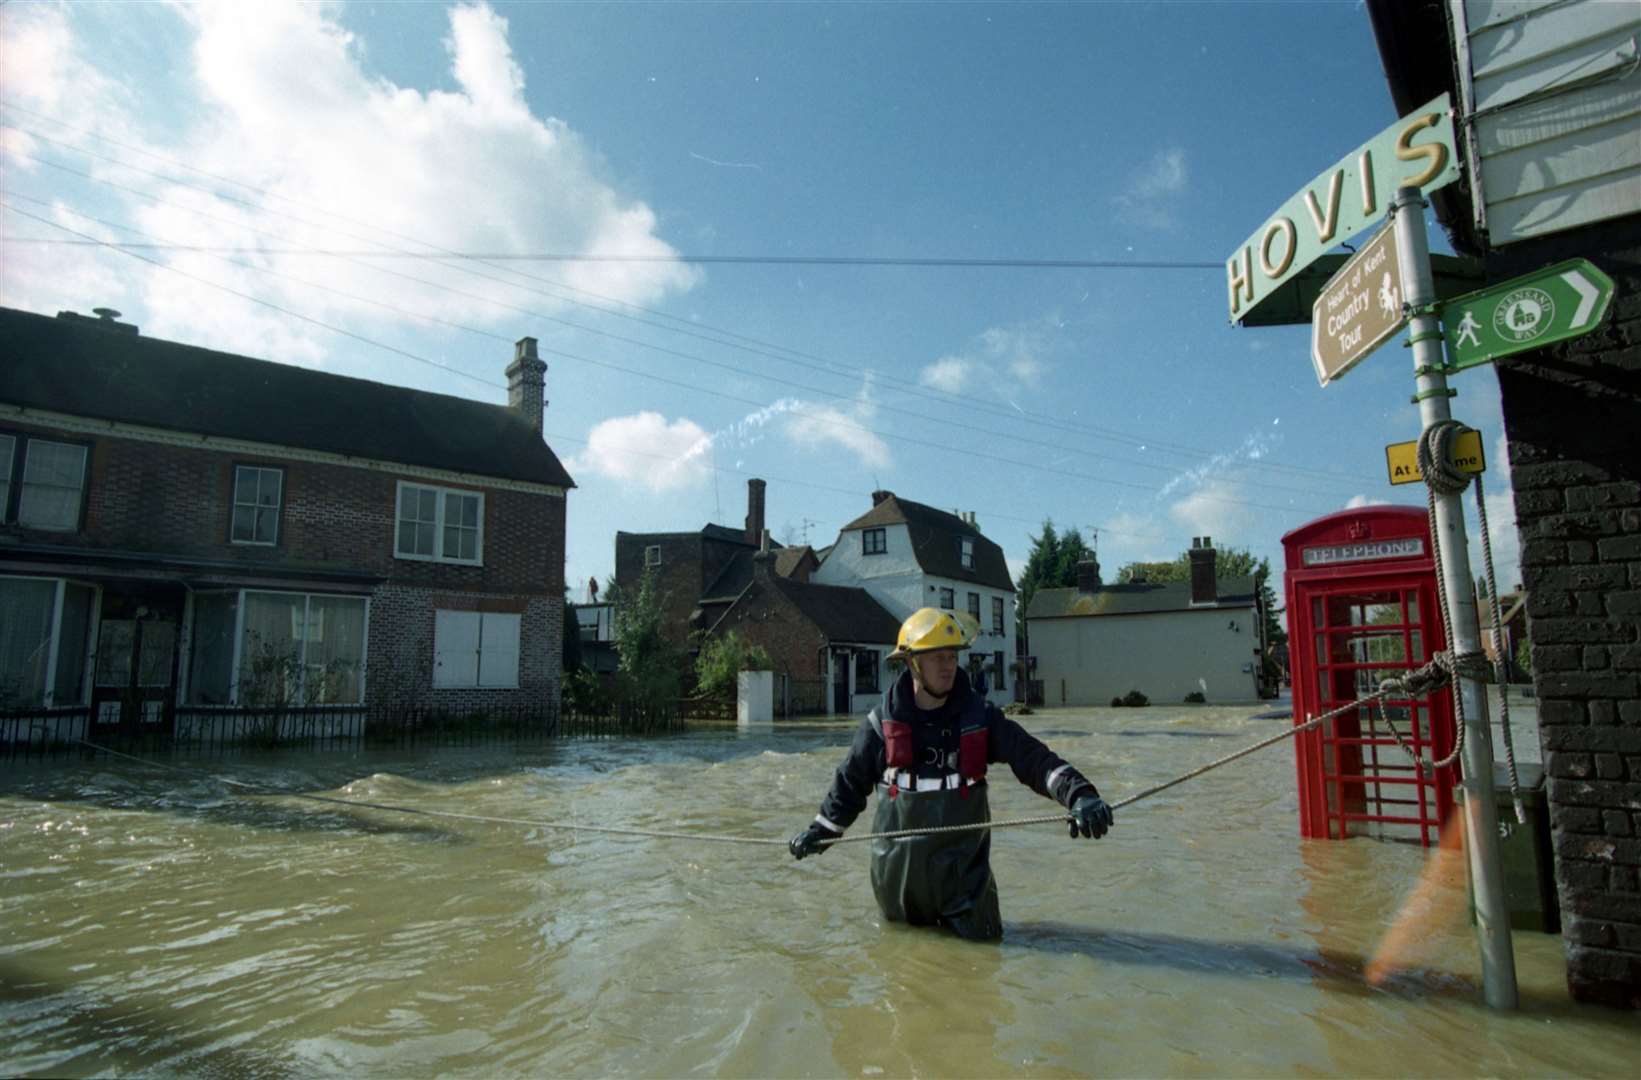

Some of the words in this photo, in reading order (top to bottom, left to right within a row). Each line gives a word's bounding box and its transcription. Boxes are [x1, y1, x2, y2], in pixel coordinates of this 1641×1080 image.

[1228, 112, 1449, 314] HOVIS
[1327, 282, 1350, 313] Heart
[1352, 267, 1361, 290] of
[1364, 244, 1387, 277] Kent
[1328, 288, 1370, 336] Country
[1495, 290, 1552, 325] GREENSAND
[1338, 323, 1362, 354] Tour
[1513, 326, 1537, 340] WAY
[1395, 465, 1410, 476] At
[1310, 541, 1414, 562] TELEPHONE
